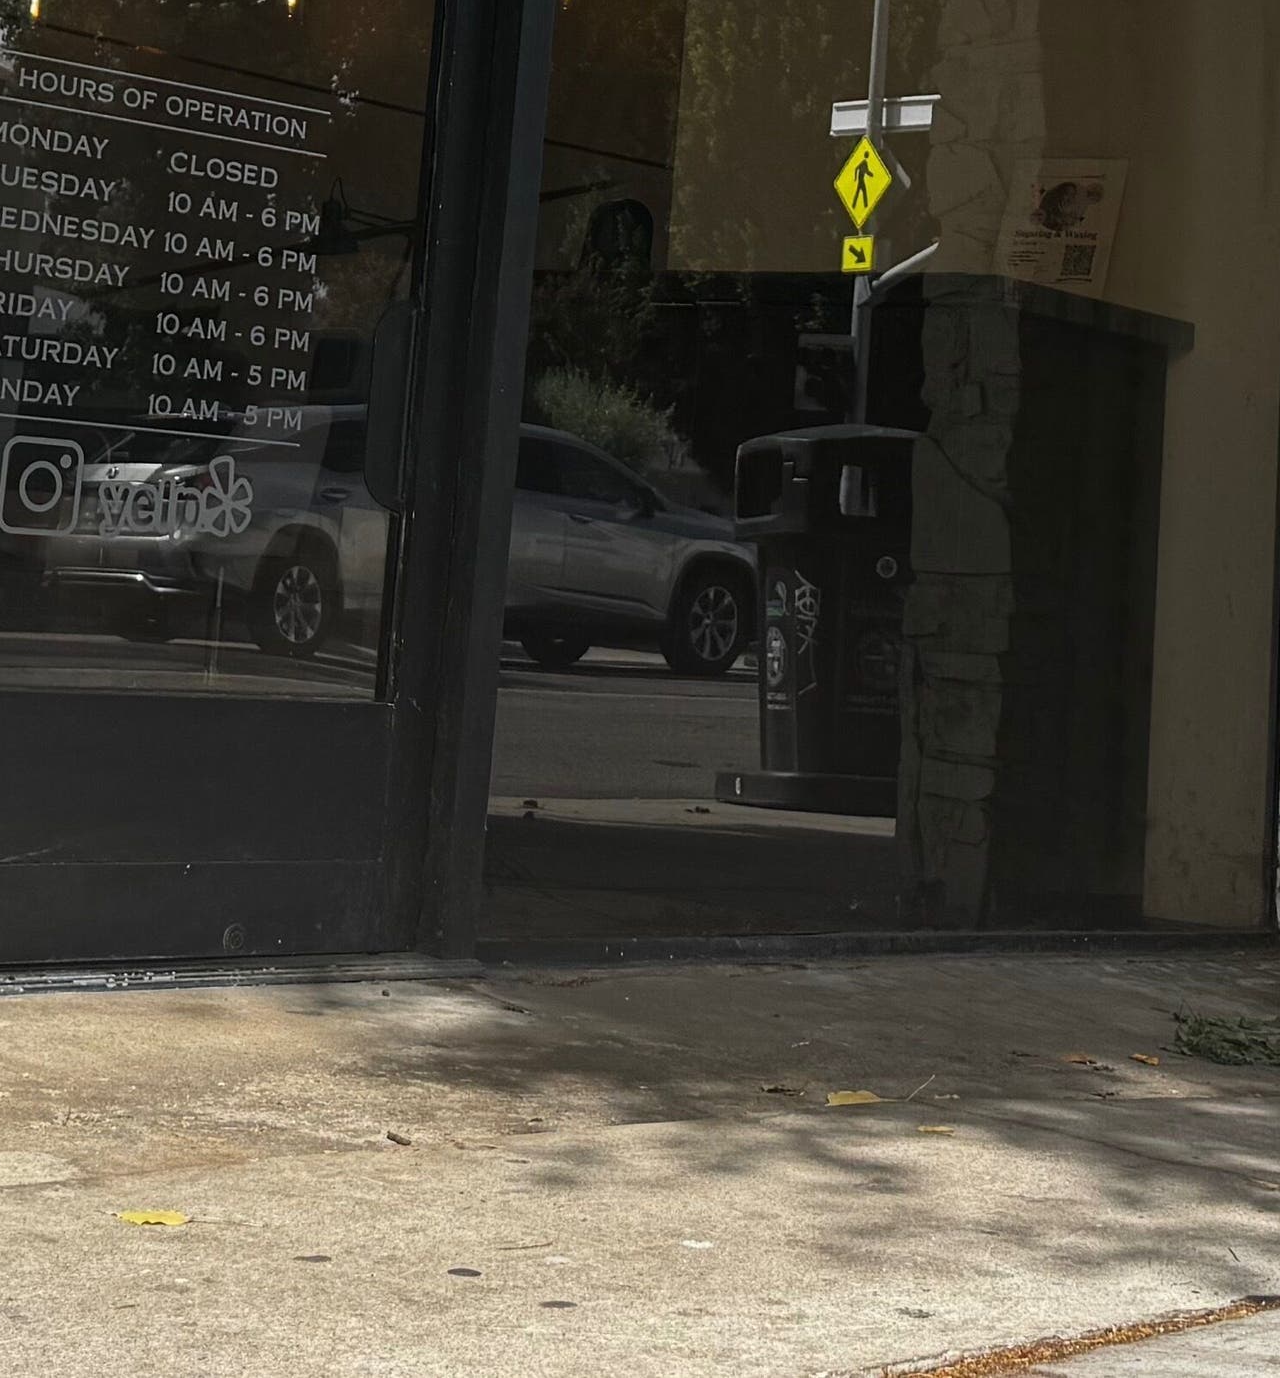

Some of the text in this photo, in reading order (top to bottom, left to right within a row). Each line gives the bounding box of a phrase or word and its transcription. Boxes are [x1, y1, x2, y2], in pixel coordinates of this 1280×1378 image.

[19, 68, 308, 140] HOURS OF OPERATION
[170, 153, 278, 189] CLOSED
[168, 192, 191, 213] 10
[200, 197, 238, 222] AM
[261, 208, 276, 227] 6
[285, 212, 320, 235] PM
[164, 232, 186, 254] 10
[195, 237, 234, 262] AM
[257, 247, 273, 267] 6
[281, 252, 317, 274] PM
[160, 272, 183, 294] 10
[192, 277, 230, 302] AM
[254, 286, 269, 306] 6
[278, 290, 314, 313] PM
[156, 313, 179, 334] 10
[187, 317, 226, 341] AM
[250, 325, 265, 345] 6
[274, 329, 310, 352] PM
[152, 354, 175, 375] 10
[183, 358, 222, 381] AM
[247, 365, 262, 385] 5
[270, 369, 306, 391] PM
[148, 395, 171, 415] 10
[181, 398, 219, 421] AM
[243, 404, 258, 425] 5
[266, 409, 302, 430] PM
[96, 479, 203, 537] yelp
